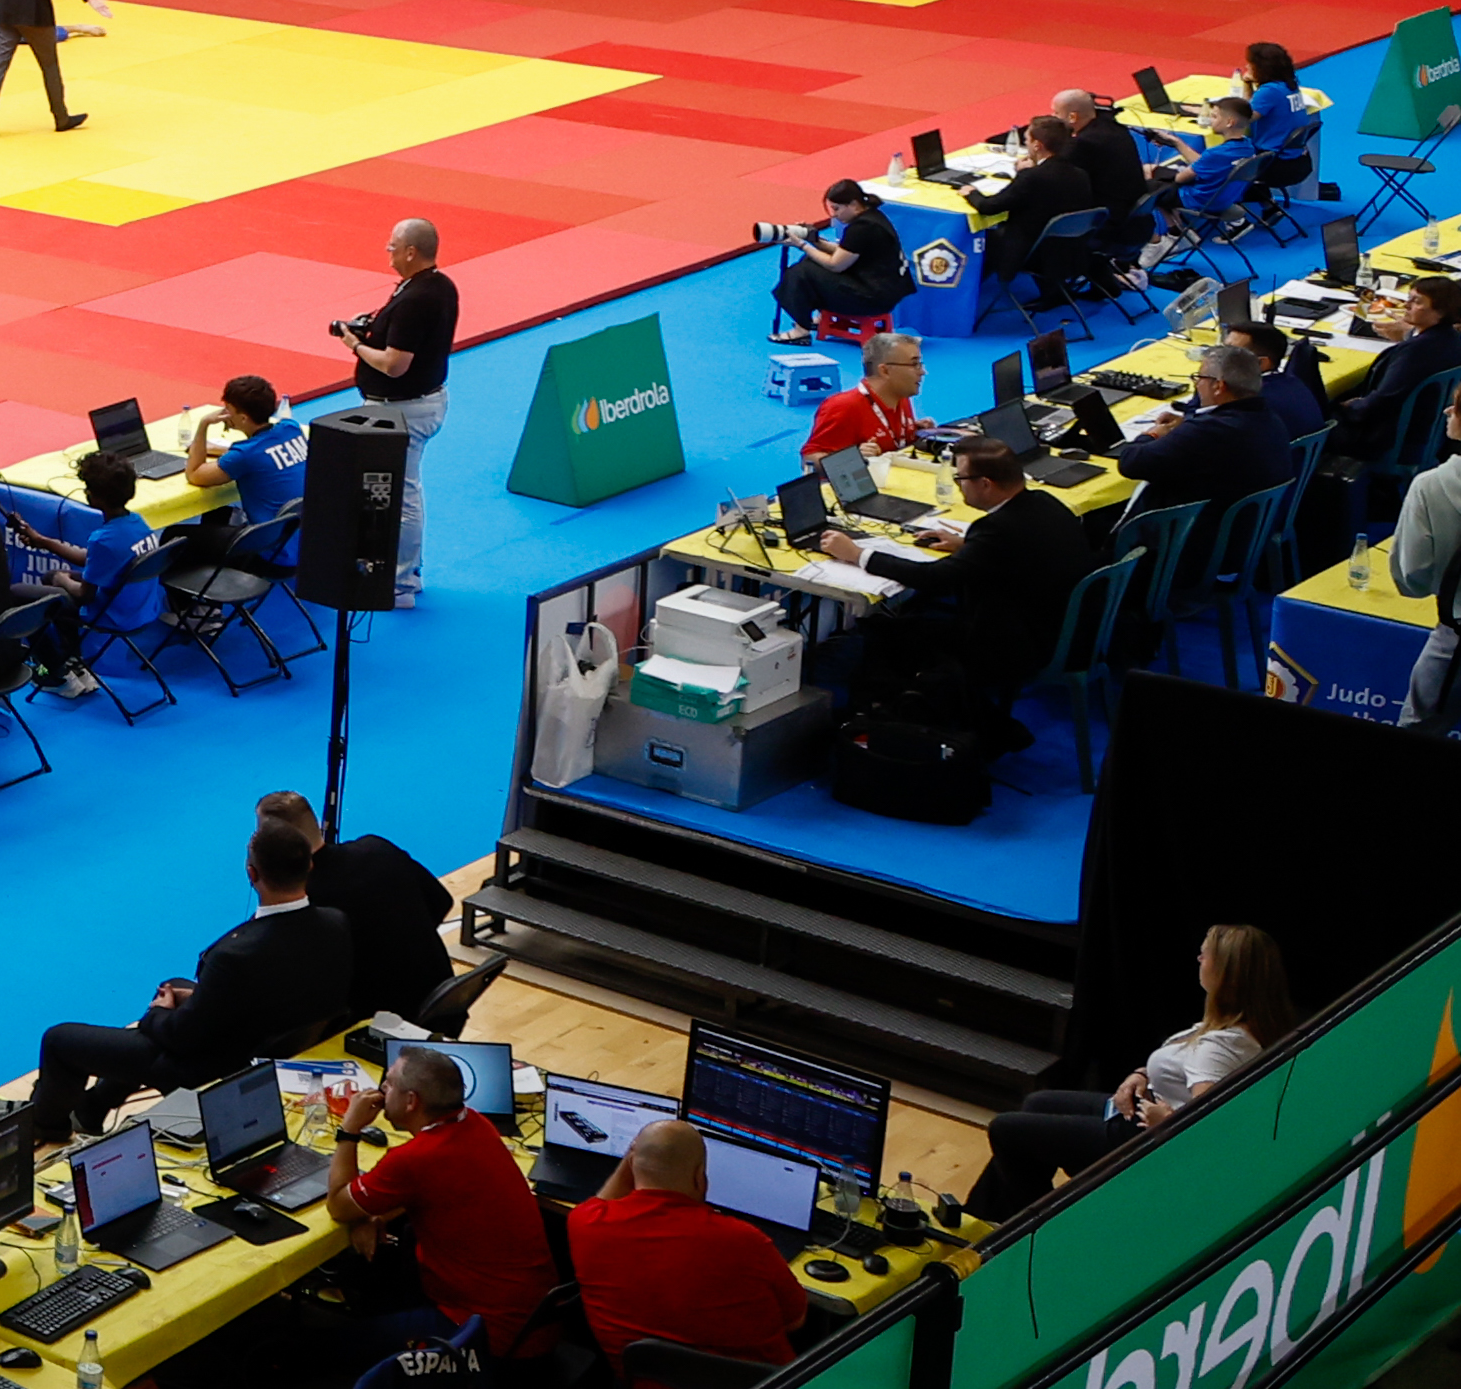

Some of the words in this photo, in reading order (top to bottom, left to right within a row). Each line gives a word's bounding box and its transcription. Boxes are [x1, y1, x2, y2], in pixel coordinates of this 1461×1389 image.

[1428, 56, 1461, 83] Iberdrola
[599, 380, 670, 425] Iberdrola
[1327, 683, 1386, 707] Judo
[678, 705, 698, 718] ECO
